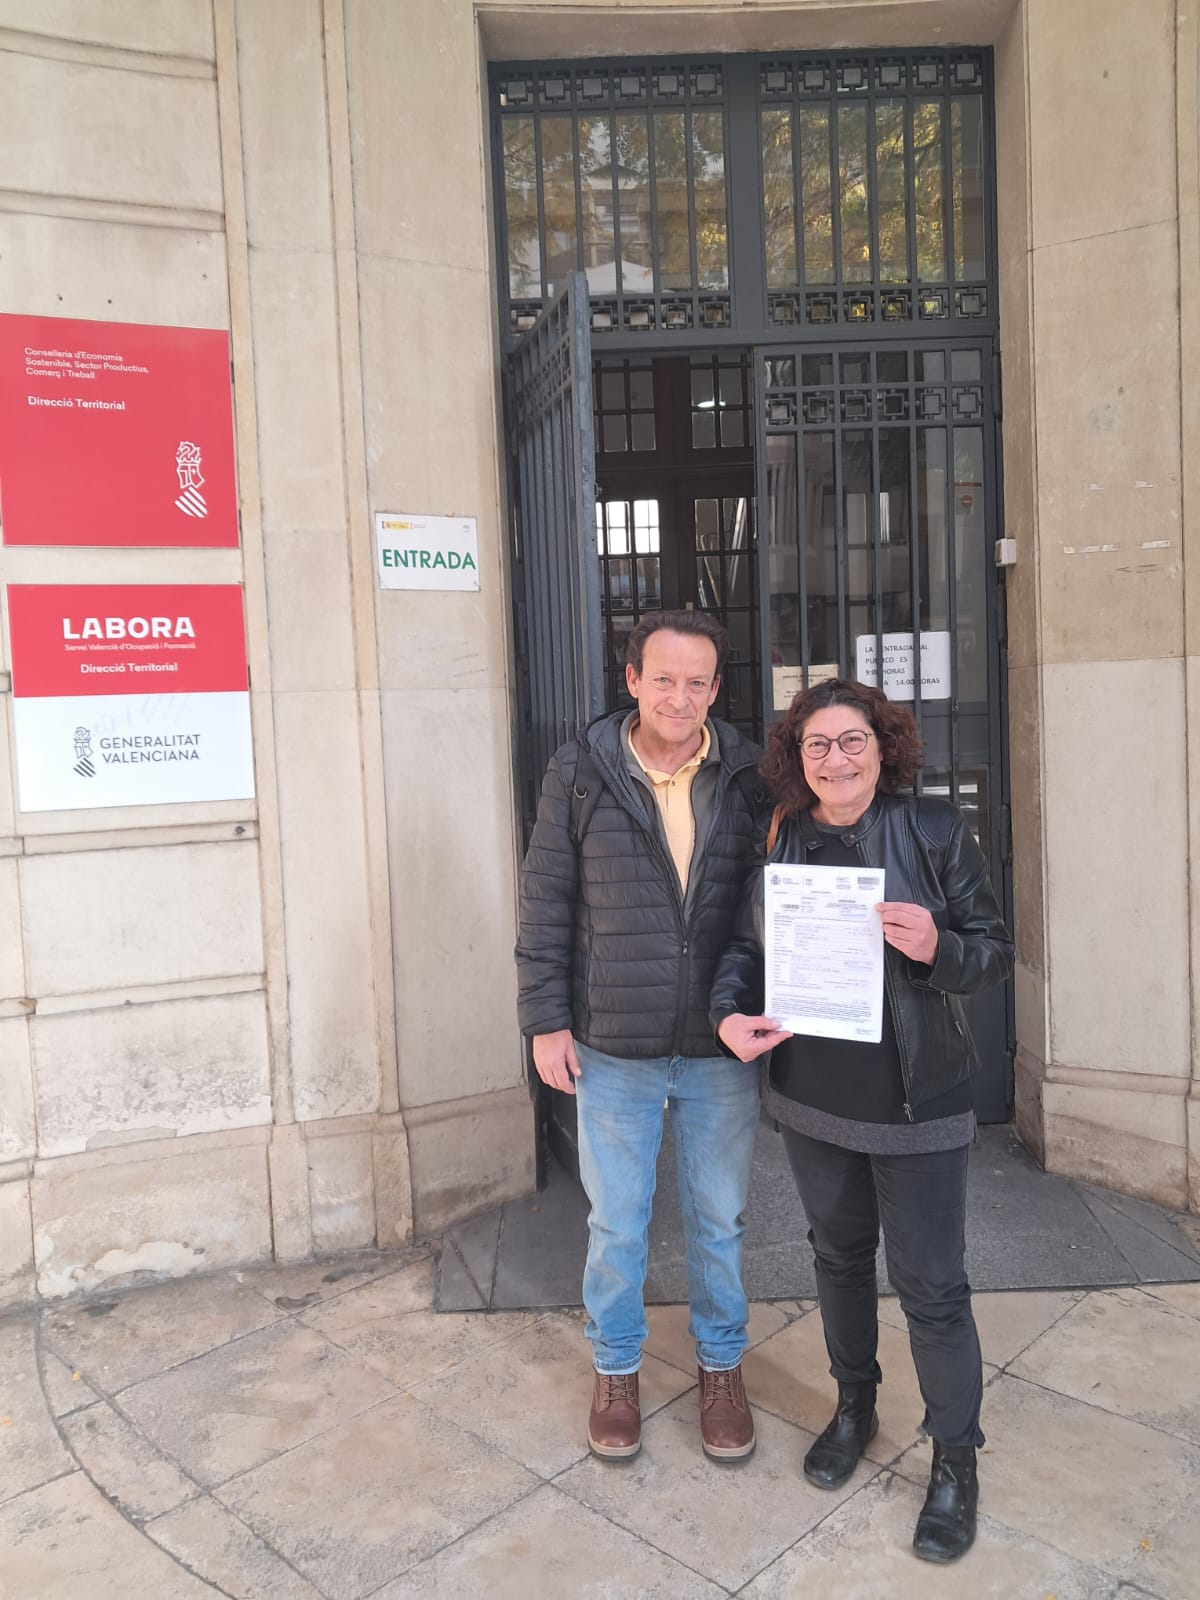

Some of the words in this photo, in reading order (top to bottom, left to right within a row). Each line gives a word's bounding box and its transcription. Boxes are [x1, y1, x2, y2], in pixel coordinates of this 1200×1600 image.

[24, 347, 73, 358] Conselleria
[26, 367, 61, 378] Comerç
[67, 369, 95, 379] Treball
[28, 396, 73, 407] Direcció
[75, 399, 125, 410] Territorial
[382, 549, 476, 570] ENTRADA
[63, 617, 195, 639] LABORA
[864, 646, 874, 654] LA
[881, 644, 913, 653] NTRADA
[80, 663, 126, 674] Direcció
[127, 661, 178, 673] Territorial
[919, 677, 941, 685] ORAS
[100, 734, 200, 749] GENERALITAT
[102, 750, 199, 763] VALENCIANA
